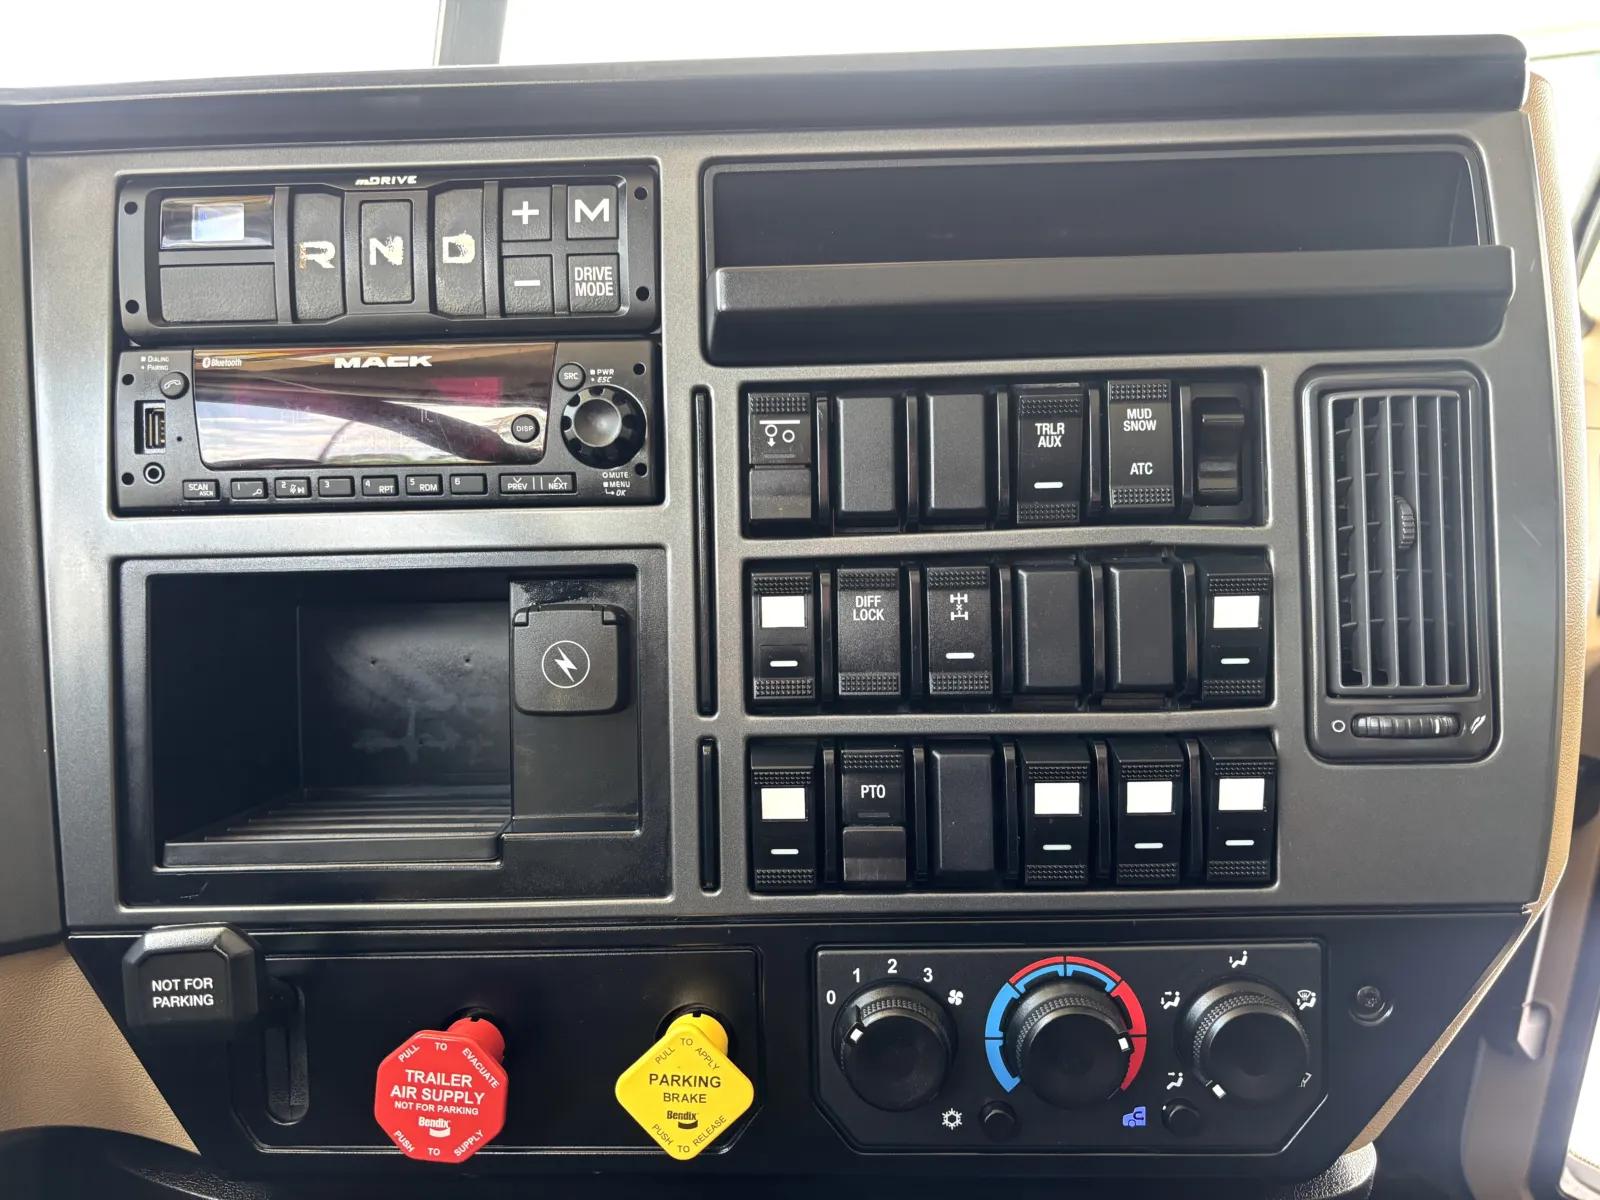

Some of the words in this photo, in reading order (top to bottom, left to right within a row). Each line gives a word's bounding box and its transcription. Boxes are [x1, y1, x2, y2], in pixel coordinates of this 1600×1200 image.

[574, 198, 609, 223] M
[369, 236, 403, 266] N
[442, 233, 475, 263] D
[299, 241, 335, 269] R
[575, 267, 613, 281] DRIVE
[575, 282, 613, 296] MODE
[211, 357, 242, 367] Bluetooth
[334, 355, 432, 369] MACK
[563, 372, 579, 380] SRC
[1127, 408, 1152, 420] MUD
[1035, 423, 1065, 436] TRLR
[1123, 420, 1157, 432] SNOW
[1038, 435, 1062, 448] AUX
[609, 471, 629, 479] MUTE
[1130, 462, 1153, 475] ATC
[188, 483, 209, 491] SCAN
[281, 481, 287, 489] 2
[324, 480, 330, 488] 3
[410, 478, 415, 486] 5
[419, 483, 438, 492] RDM
[507, 482, 528, 490] PREV
[548, 482, 569, 490] NEXT
[379, 485, 394, 494] RPT
[616, 489, 627, 497] OK
[855, 595, 881, 608] DIFF
[853, 608, 885, 621] LOCK
[861, 784, 886, 799] PTO
[152, 979, 181, 992] NOT
[184, 977, 213, 990] FOR
[826, 990, 836, 1005] 0
[852, 968, 861, 983] 1
[887, 958, 898, 974] 2
[923, 967, 933, 983] 3
[153, 993, 214, 1009] PARKING
[655, 1047, 676, 1065] PULL
[680, 1037, 694, 1046] TO
[695, 1047, 720, 1071] APPLY
[397, 1044, 420, 1063] PULL
[435, 1042, 448, 1051] TO
[462, 1047, 500, 1089] EVACUATE
[405, 1069, 473, 1088] TRAILER
[649, 1073, 721, 1088] PARKING
[390, 1085, 417, 1100] AIR
[421, 1087, 486, 1105] SUPPLY
[663, 1092, 707, 1104] BRAKE
[394, 1100, 414, 1111] NOT
[415, 1103, 435, 1113] FOR
[437, 1105, 479, 1116] PARKING
[666, 1110, 697, 1121] Bendix
[418, 1116, 449, 1129] Bendix
[651, 1123, 674, 1146] PUSH
[677, 1145, 691, 1154] TO
[692, 1115, 727, 1147] RELEASE
[393, 1130, 416, 1153] PUSH
[428, 1147, 441, 1157] TO
[454, 1129, 484, 1157] SUPPLY
